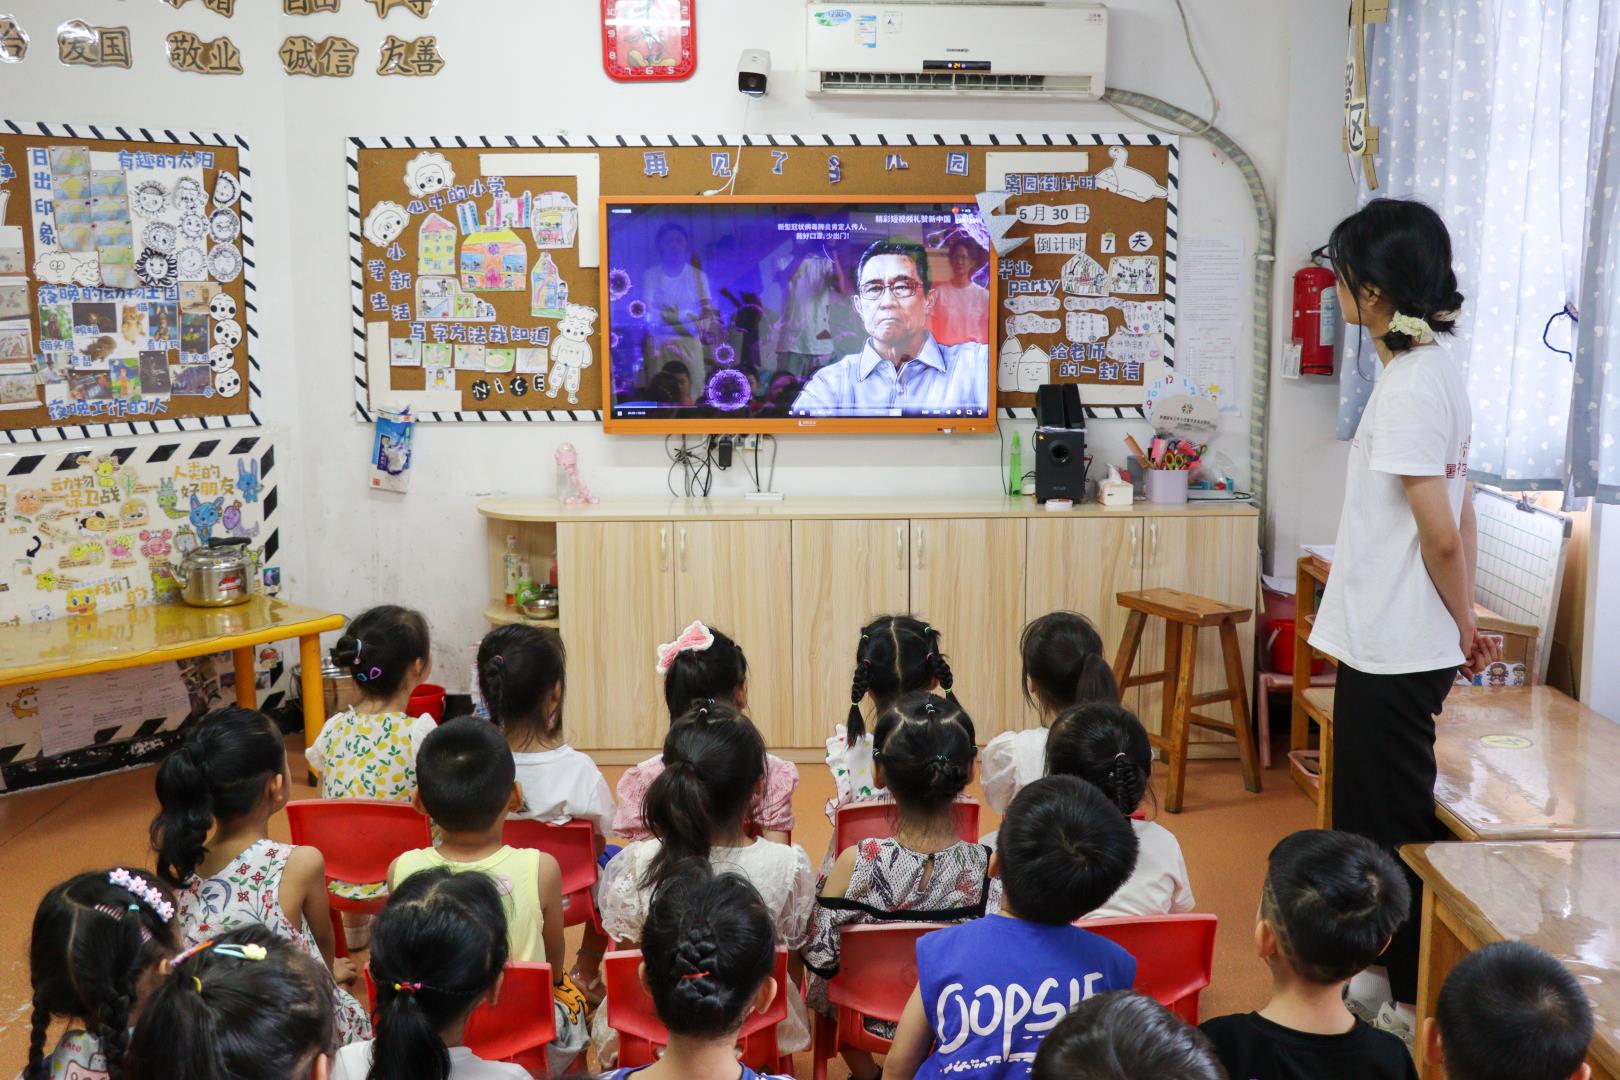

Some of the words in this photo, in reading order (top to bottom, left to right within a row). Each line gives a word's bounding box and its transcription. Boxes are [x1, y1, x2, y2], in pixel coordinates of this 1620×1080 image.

[170, 34, 241, 72] 敬业
[282, 39, 355, 75] 诚信
[381, 38, 443, 74] 友善
[118, 151, 214, 170] 有趣的太阳
[408, 177, 505, 213] 心中的小学
[1005, 174, 1097, 195] 离园倒计时
[32, 148, 57, 246] 日出印象
[1036, 236, 1084, 253] 倒计时
[1104, 239, 1113, 251] 7
[998, 259, 1032, 279] 毕业
[1008, 280, 1060, 297] party
[409, 322, 550, 345] 写字方法我知道
[1050, 342, 1106, 361] 给老师
[1060, 360, 1140, 380] 的一封信
[48, 399, 168, 421] 夜晚工作的人
